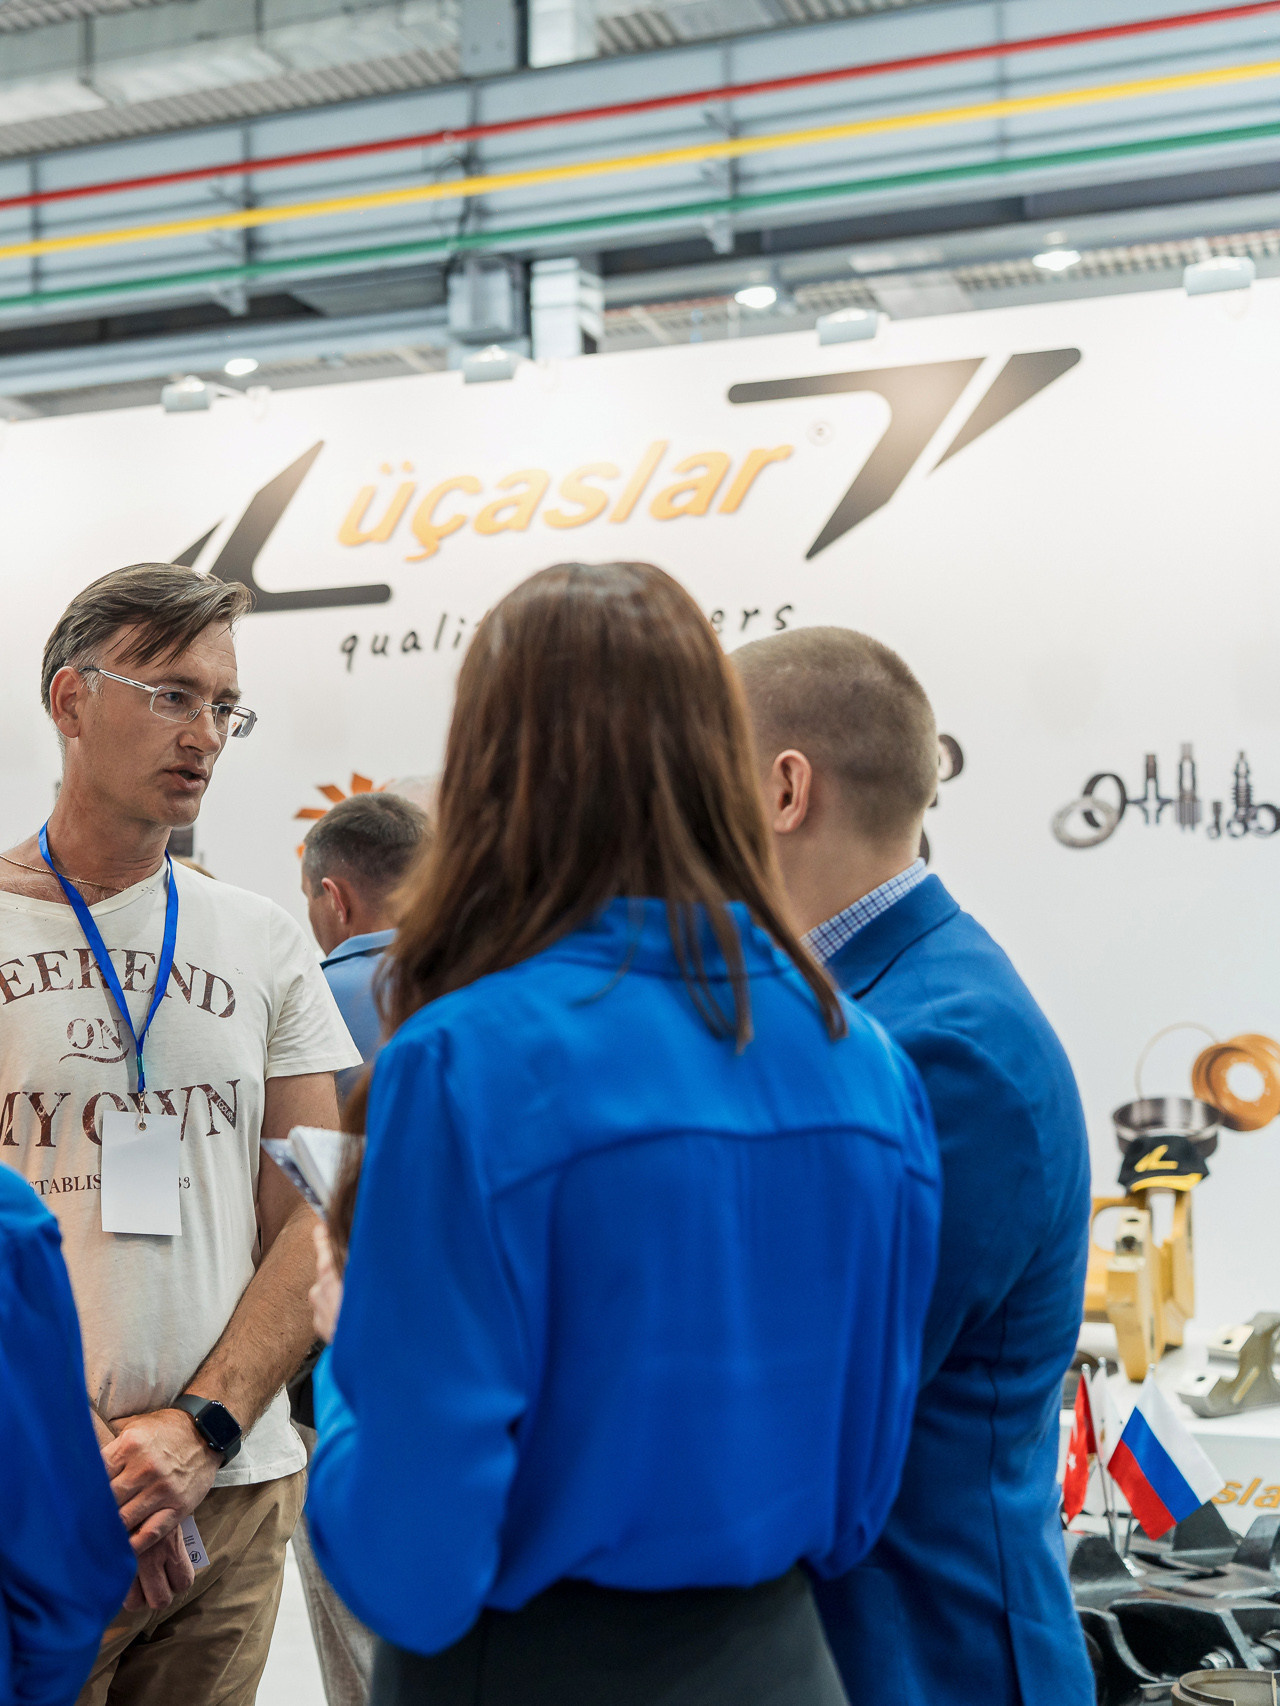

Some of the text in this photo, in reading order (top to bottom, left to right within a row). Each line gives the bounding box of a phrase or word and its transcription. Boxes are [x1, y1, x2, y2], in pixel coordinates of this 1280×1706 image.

[337, 439, 795, 562] üçaslar
[340, 612, 481, 673] quali
[66, 1018, 124, 1051] ON
